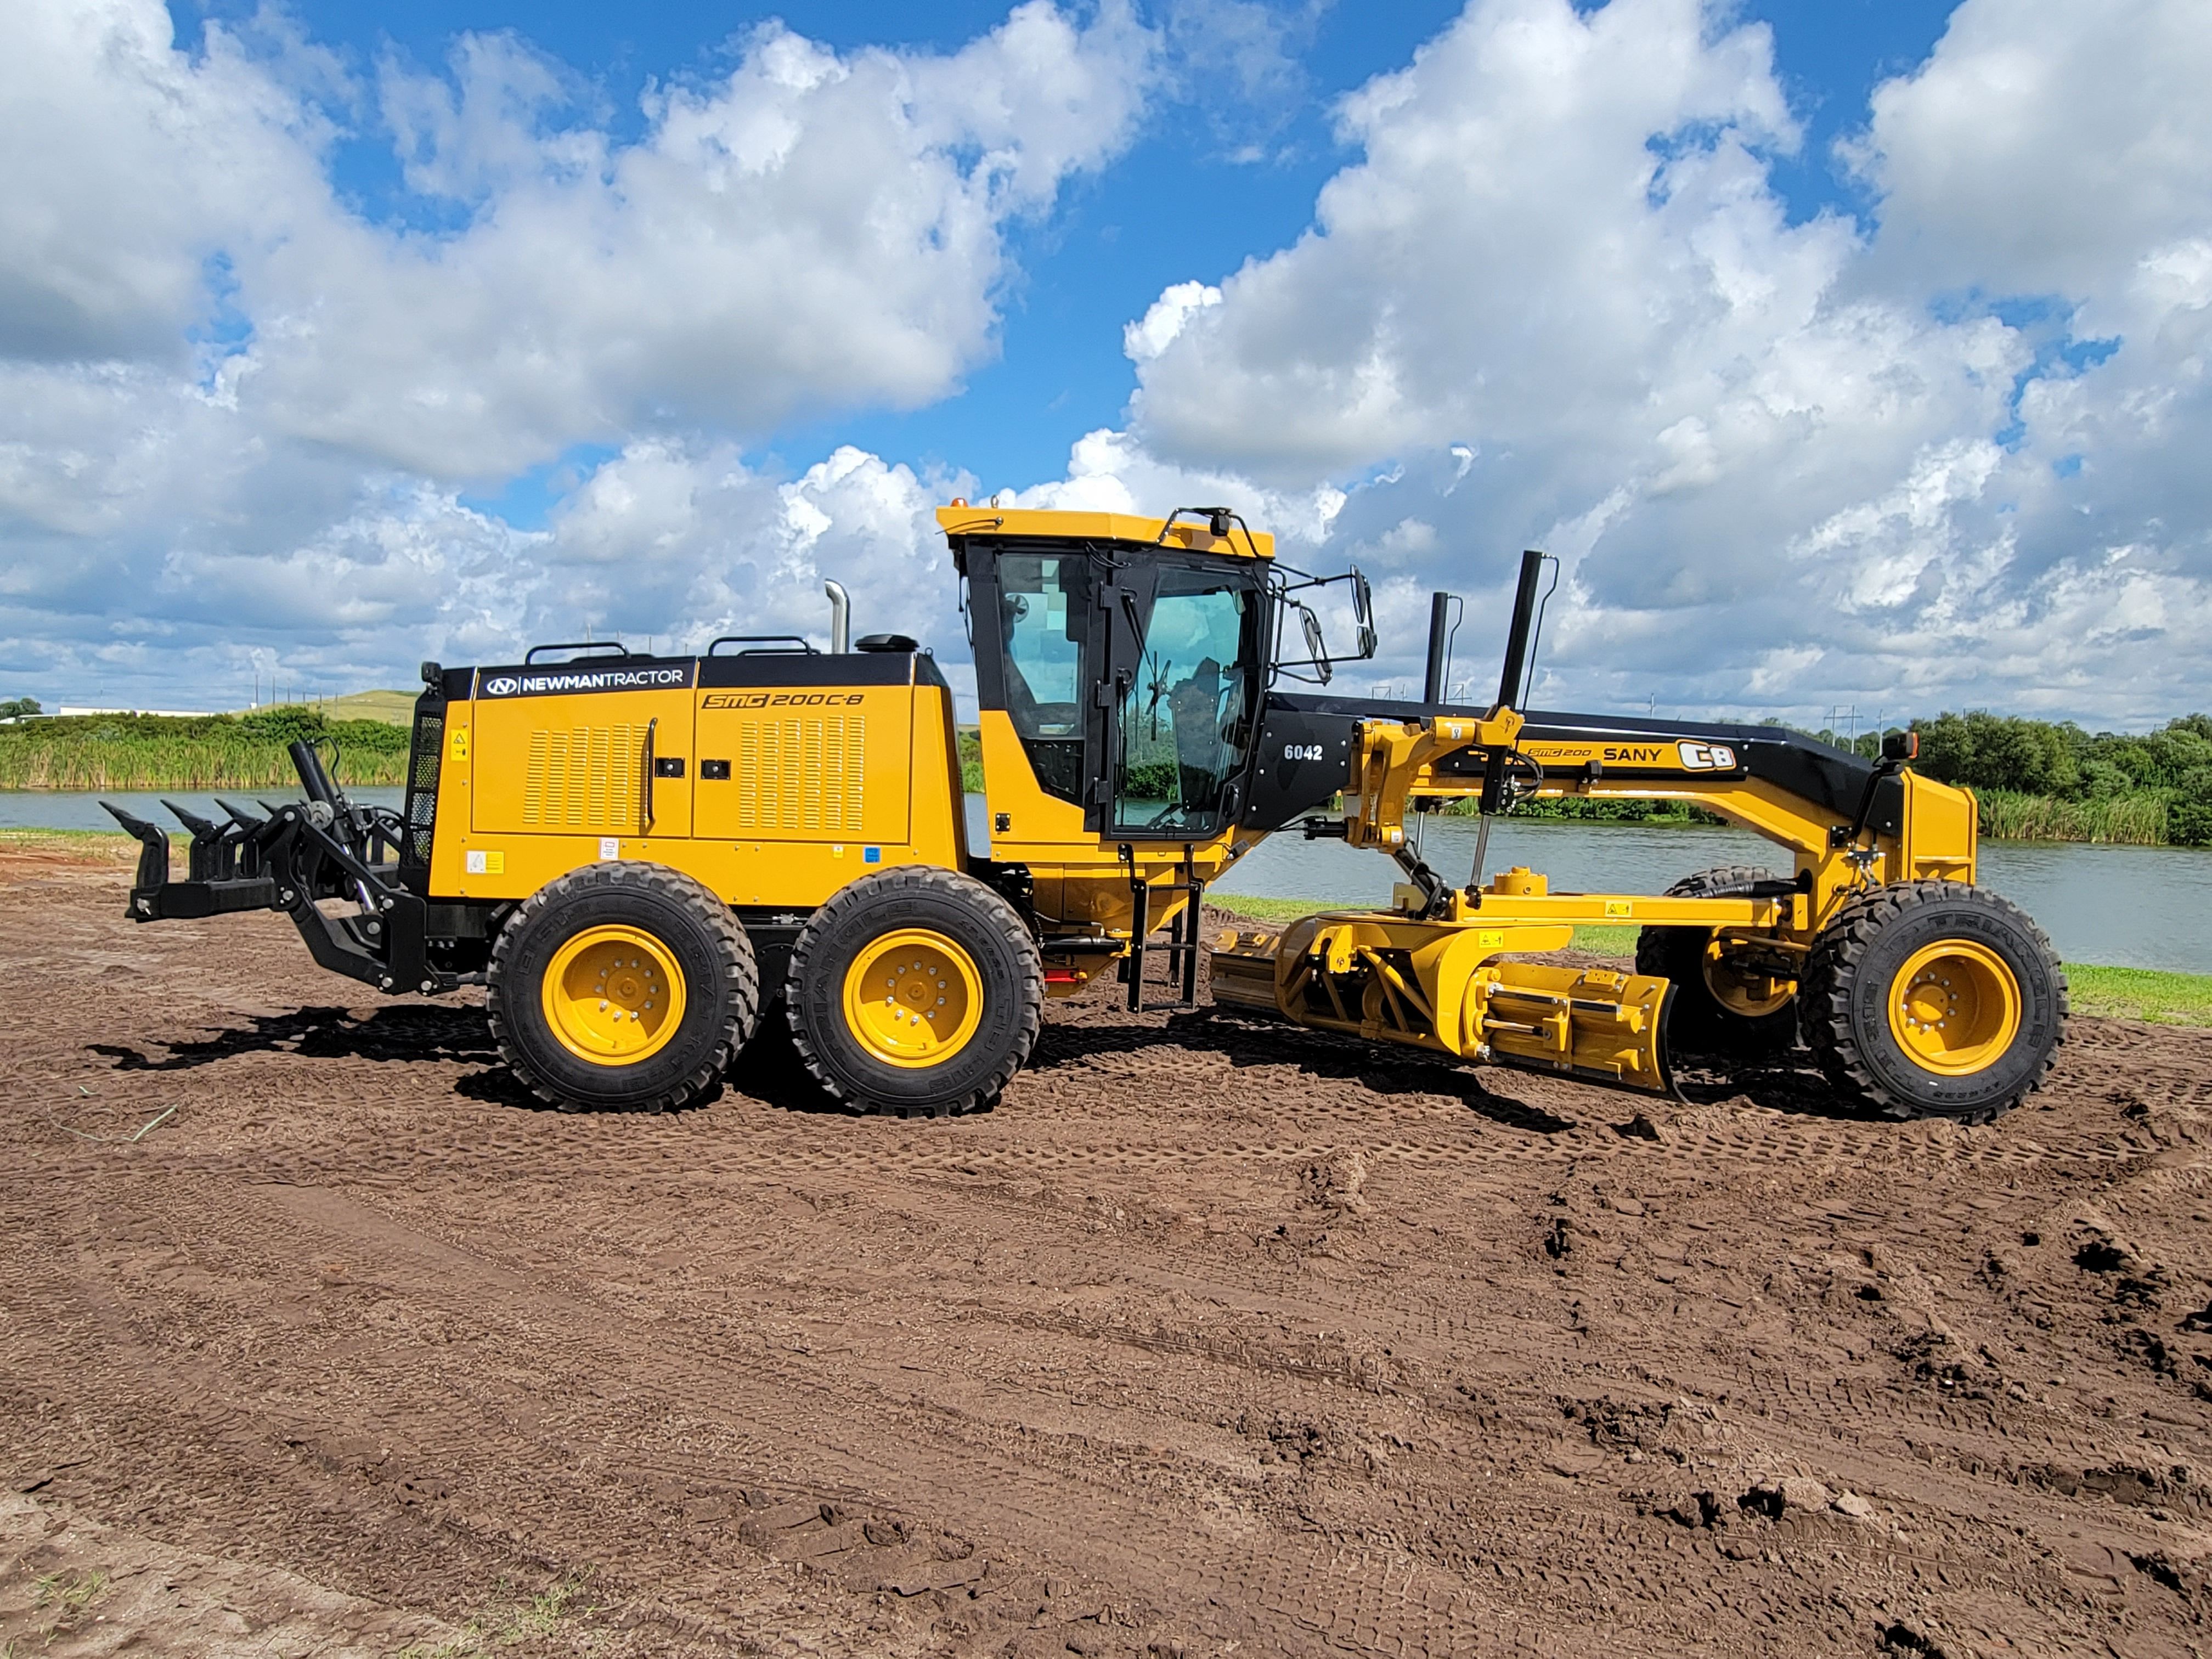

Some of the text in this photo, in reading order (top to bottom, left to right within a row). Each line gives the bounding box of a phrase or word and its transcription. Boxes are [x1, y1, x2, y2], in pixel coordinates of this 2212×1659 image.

[523, 669, 684, 691] NEWMANTRACTOR
[702, 694, 769, 709] SMG
[1284, 744, 1323, 760] 6042
[1528, 741, 1735, 769] SMG 200 SANY C8
[813, 899, 913, 1069] TRIANGLE
[1927, 913, 2046, 1047] TRIANGLE
